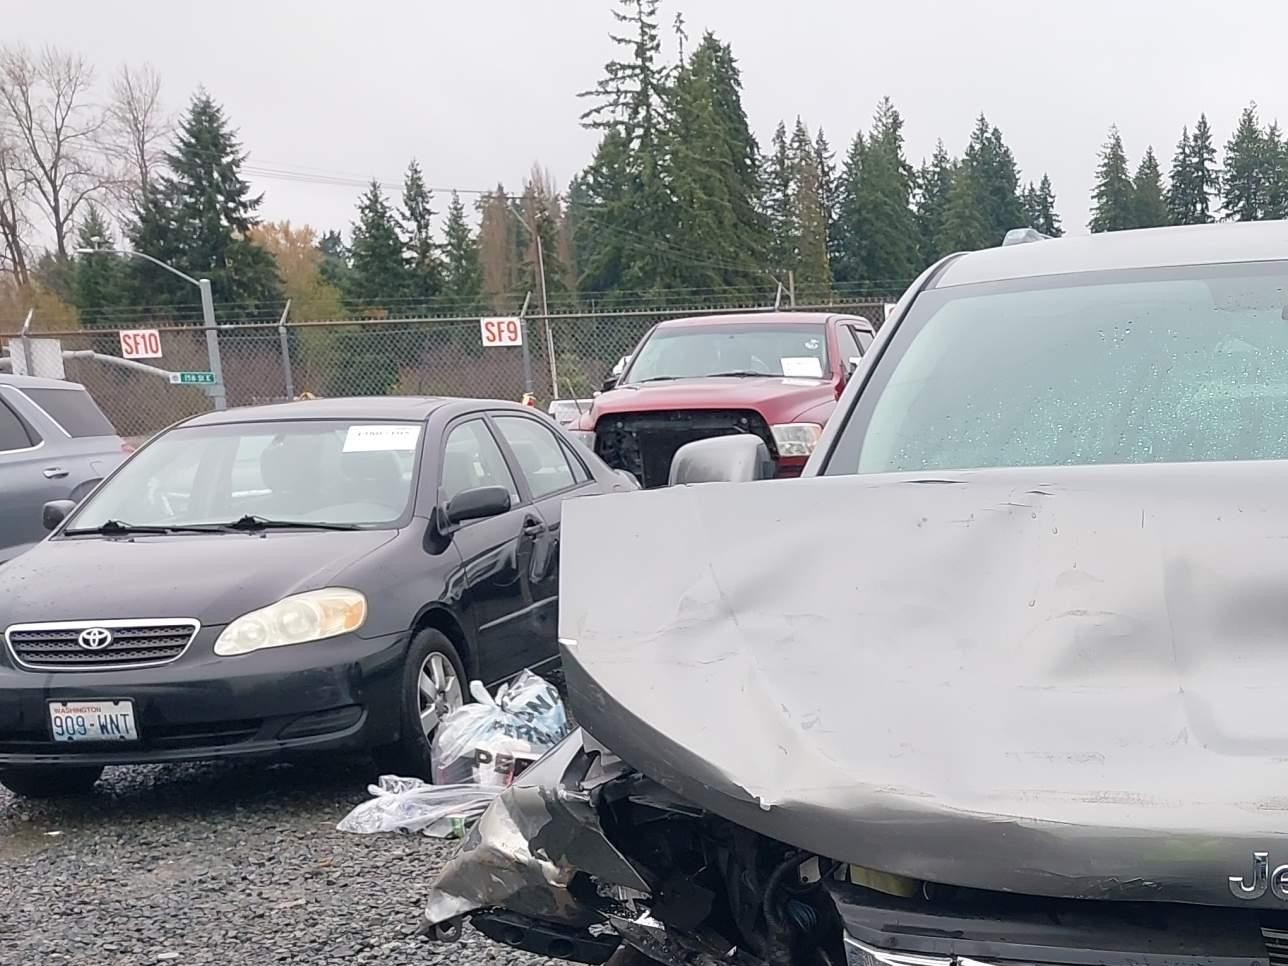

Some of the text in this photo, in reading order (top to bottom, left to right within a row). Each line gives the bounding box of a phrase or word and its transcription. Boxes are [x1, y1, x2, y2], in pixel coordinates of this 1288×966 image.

[485, 320, 518, 342] SF9
[122, 333, 159, 355] SF10
[54, 706, 102, 714] WASHINGTON
